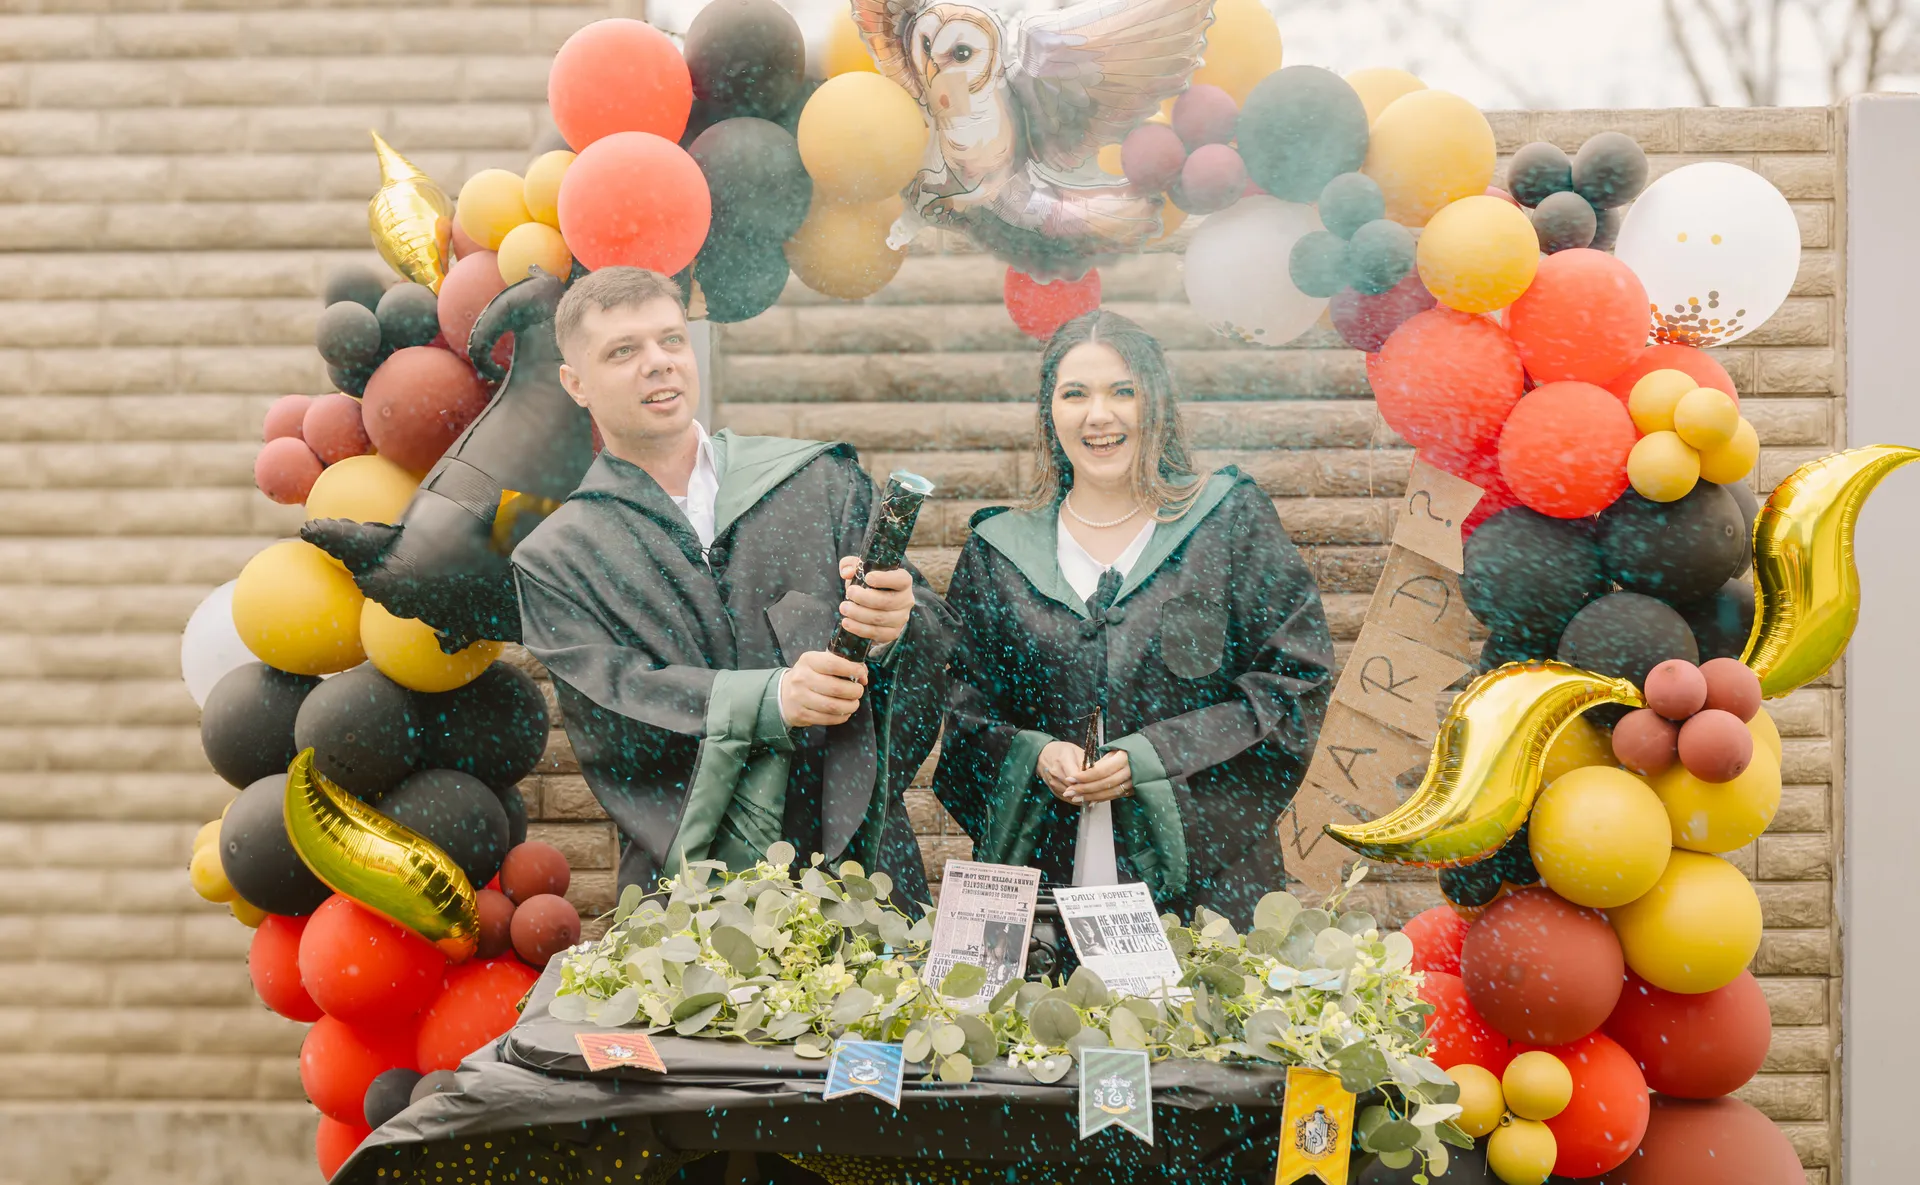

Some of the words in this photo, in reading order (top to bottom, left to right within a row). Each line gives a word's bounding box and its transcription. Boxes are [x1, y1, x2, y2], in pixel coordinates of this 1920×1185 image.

[963, 881, 999, 891] CONFISCATED
[1000, 884, 1019, 893] WANDS
[1071, 893, 1096, 902] DAILY
[1097, 915, 1110, 926] HE
[1110, 913, 1130, 925] WHO
[1130, 912, 1155, 924] MUST
[1101, 926, 1119, 937] NOT
[1119, 925, 1131, 936] BE
[1131, 923, 1159, 935] NAMED
[1107, 934, 1167, 954] RETURNS
[935, 952, 978, 961] CONFIRMED
[933, 958, 952, 966] SNAPE
